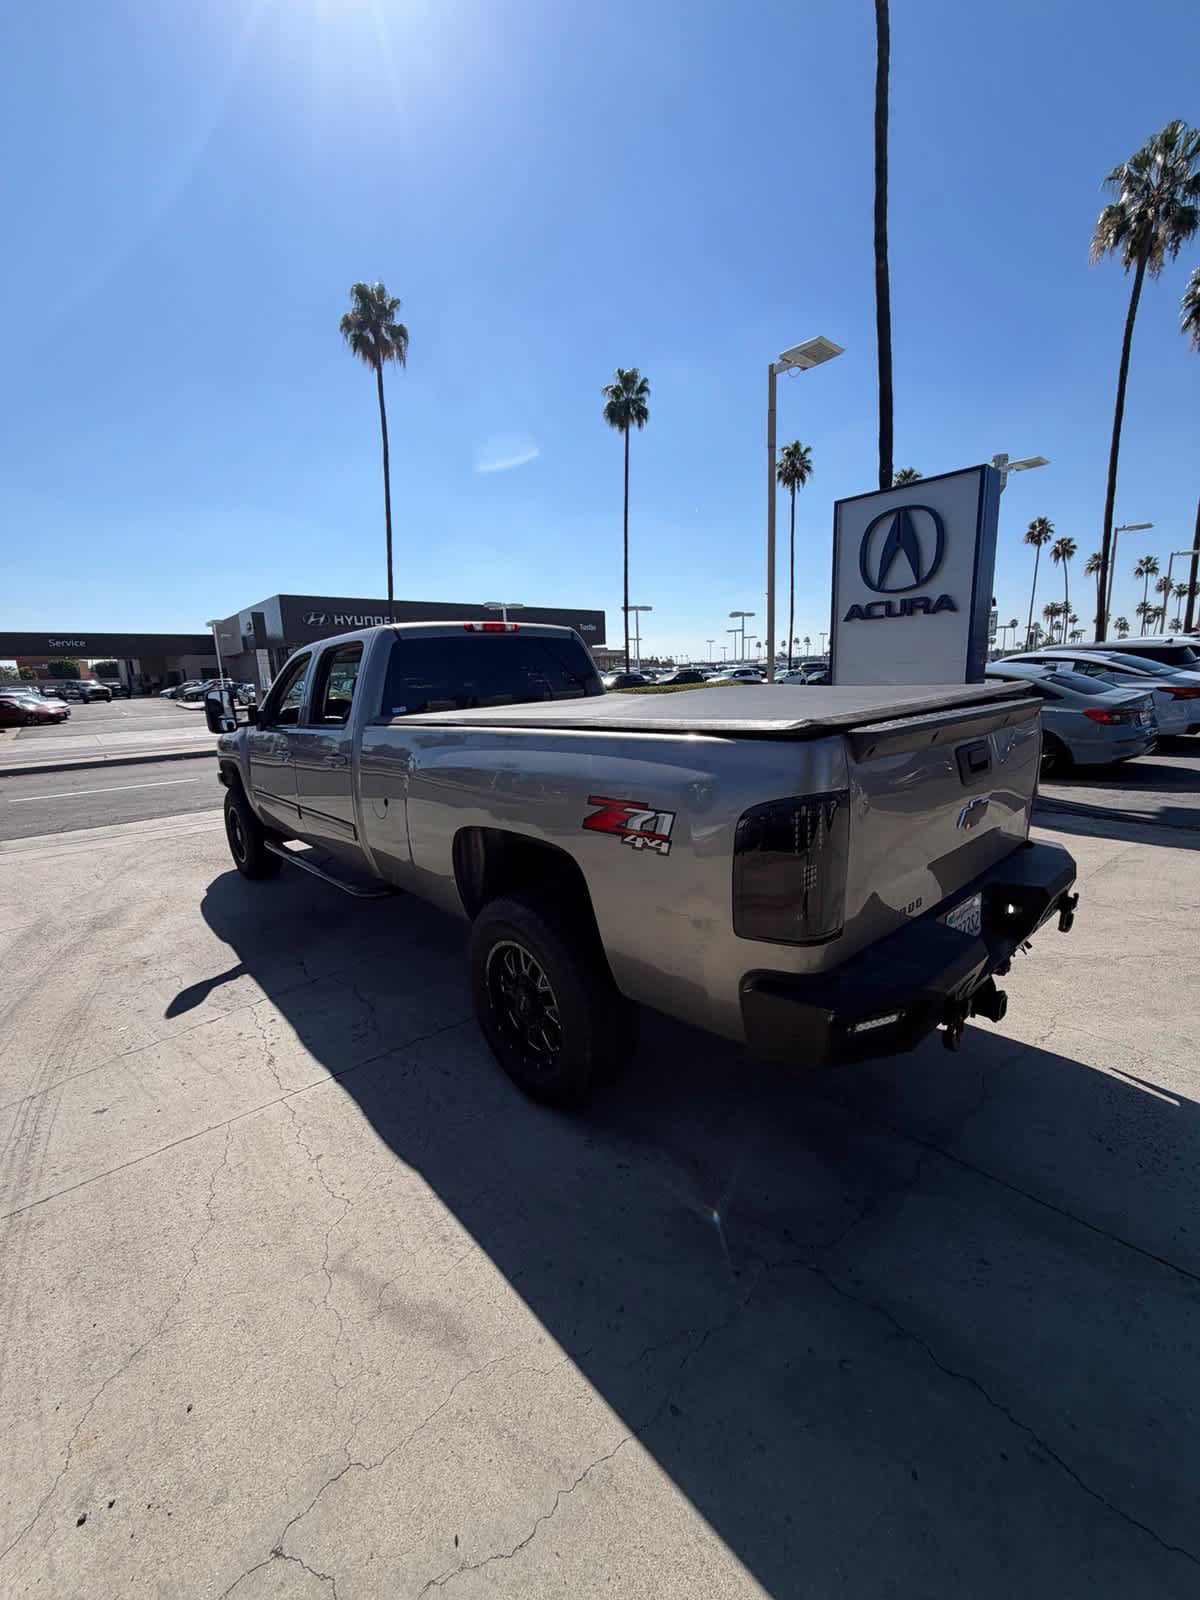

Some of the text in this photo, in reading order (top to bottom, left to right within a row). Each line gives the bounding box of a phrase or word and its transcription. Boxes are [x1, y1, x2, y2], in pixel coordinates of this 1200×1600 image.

[843, 594, 958, 622] ACURA
[48, 639, 87, 648] Service
[582, 794, 676, 842] Z71
